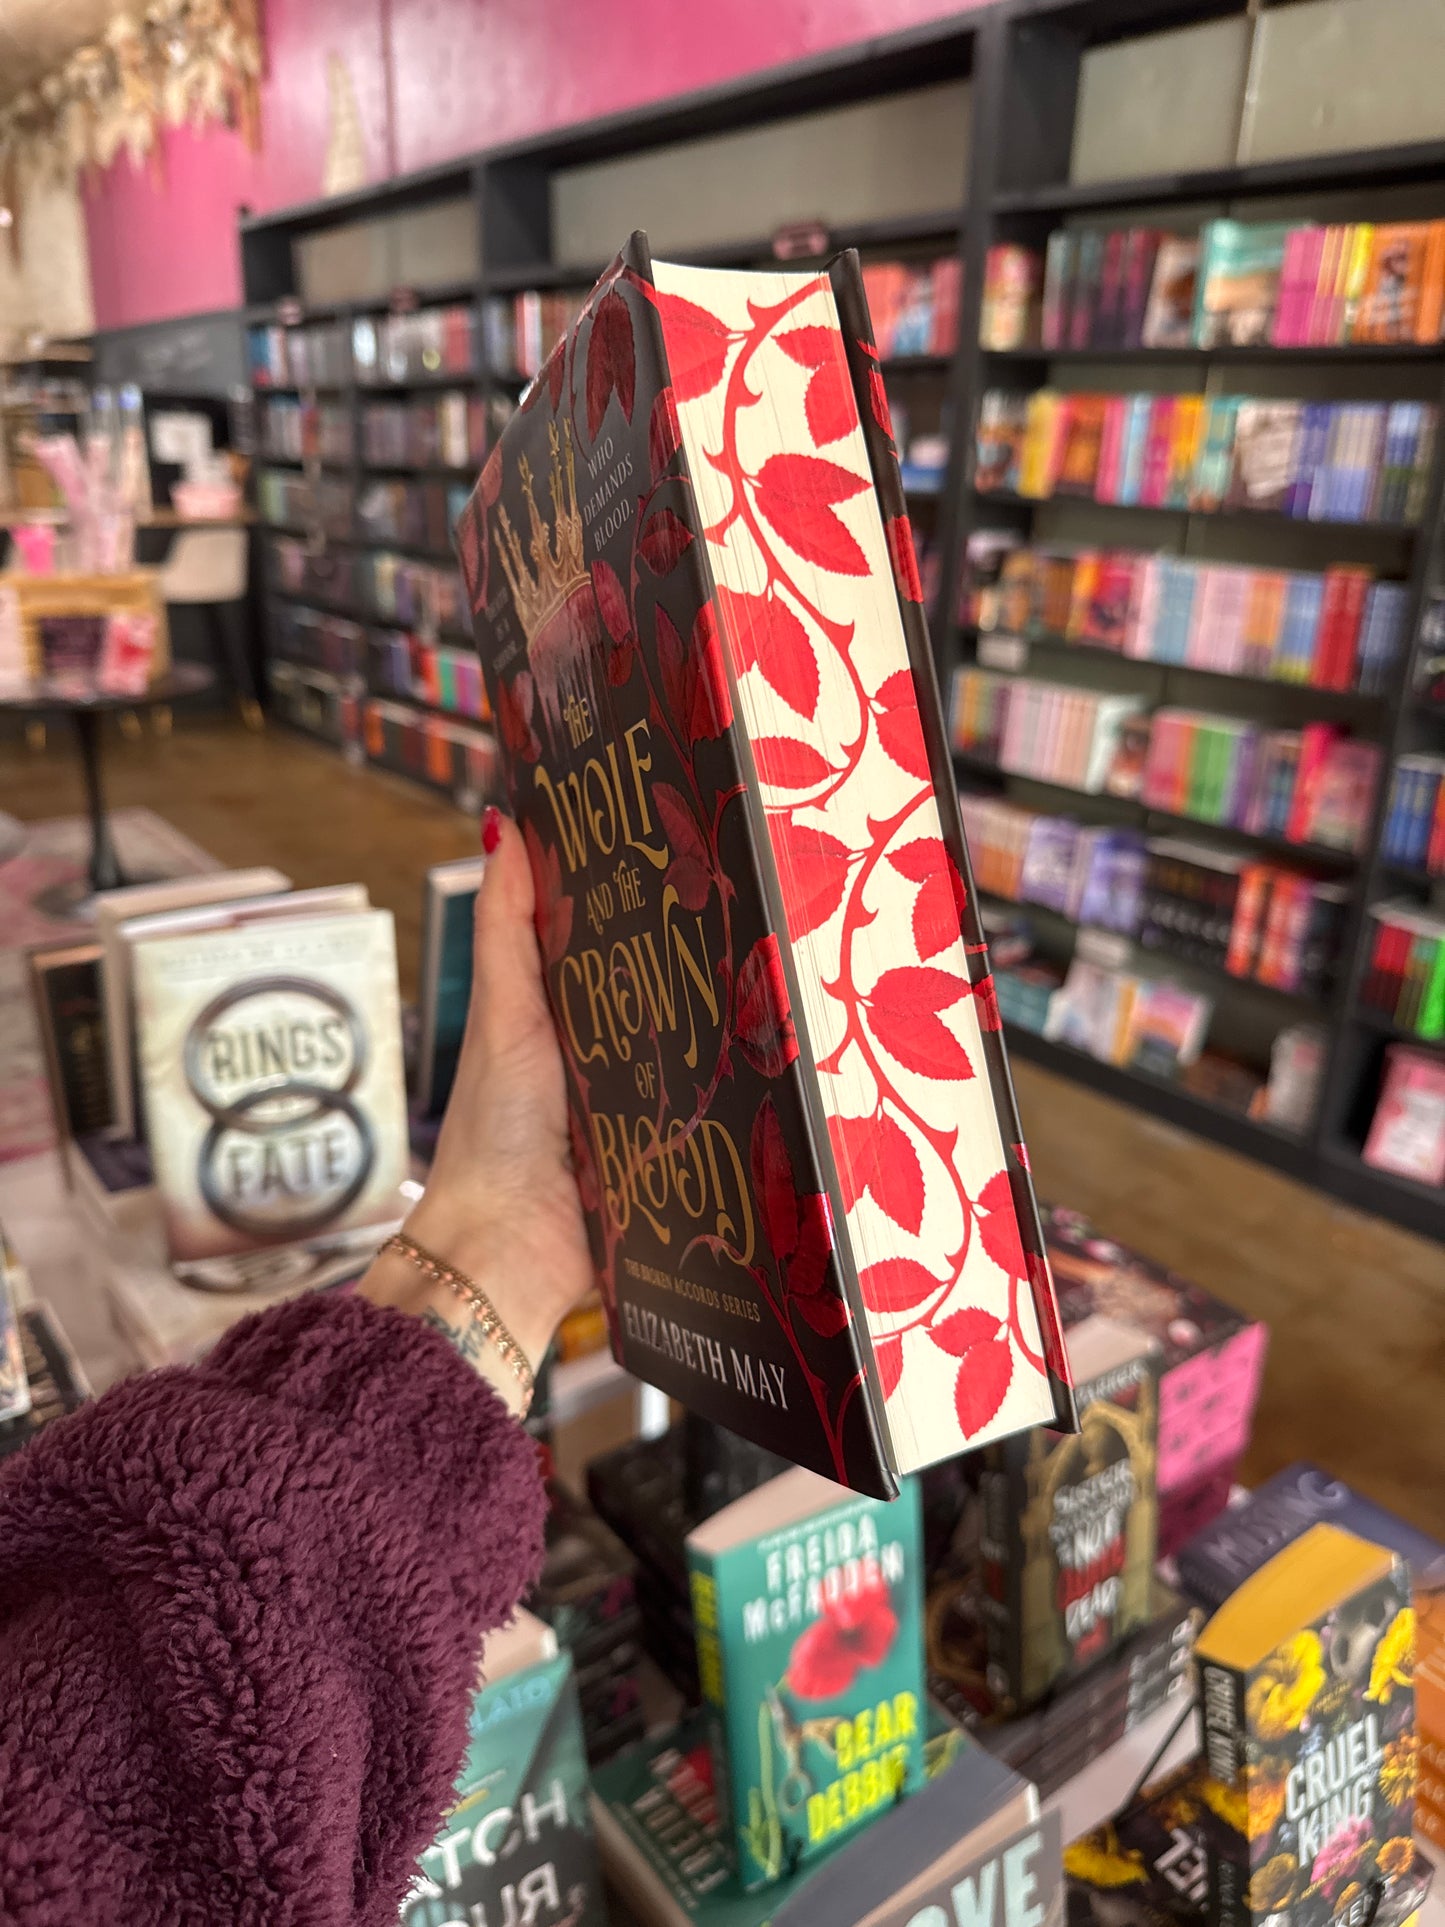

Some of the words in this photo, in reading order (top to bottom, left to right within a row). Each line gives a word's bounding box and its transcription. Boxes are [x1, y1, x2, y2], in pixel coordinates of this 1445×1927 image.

[582, 453, 634, 526] DEMANDS
[587, 436, 614, 480] WHO
[594, 498, 635, 552] BLOOD.
[563, 694, 594, 749] THE
[534, 718, 669, 873] WOLF
[585, 877, 614, 935] AND
[613, 858, 646, 913] THE
[559, 884, 719, 1070] CROWN
[207, 1018, 347, 1082] RINGS
[635, 1061, 656, 1100] OF
[228, 1132, 346, 1199] FATE
[591, 1112, 755, 1266] BLOOD
[624, 1257, 642, 1279] THE
[640, 1264, 673, 1290] BROKEN
[674, 1277, 720, 1309] ACCORDS
[722, 1292, 761, 1322] SERIES
[623, 1301, 728, 1385] ELIZABETH
[730, 1347, 788, 1411] MAY
[766, 1513, 878, 1594] FREIDA
[835, 1691, 918, 1771] DEAR
[1285, 1713, 1384, 1821] CRUEL
[1298, 1775, 1375, 1869] KING
